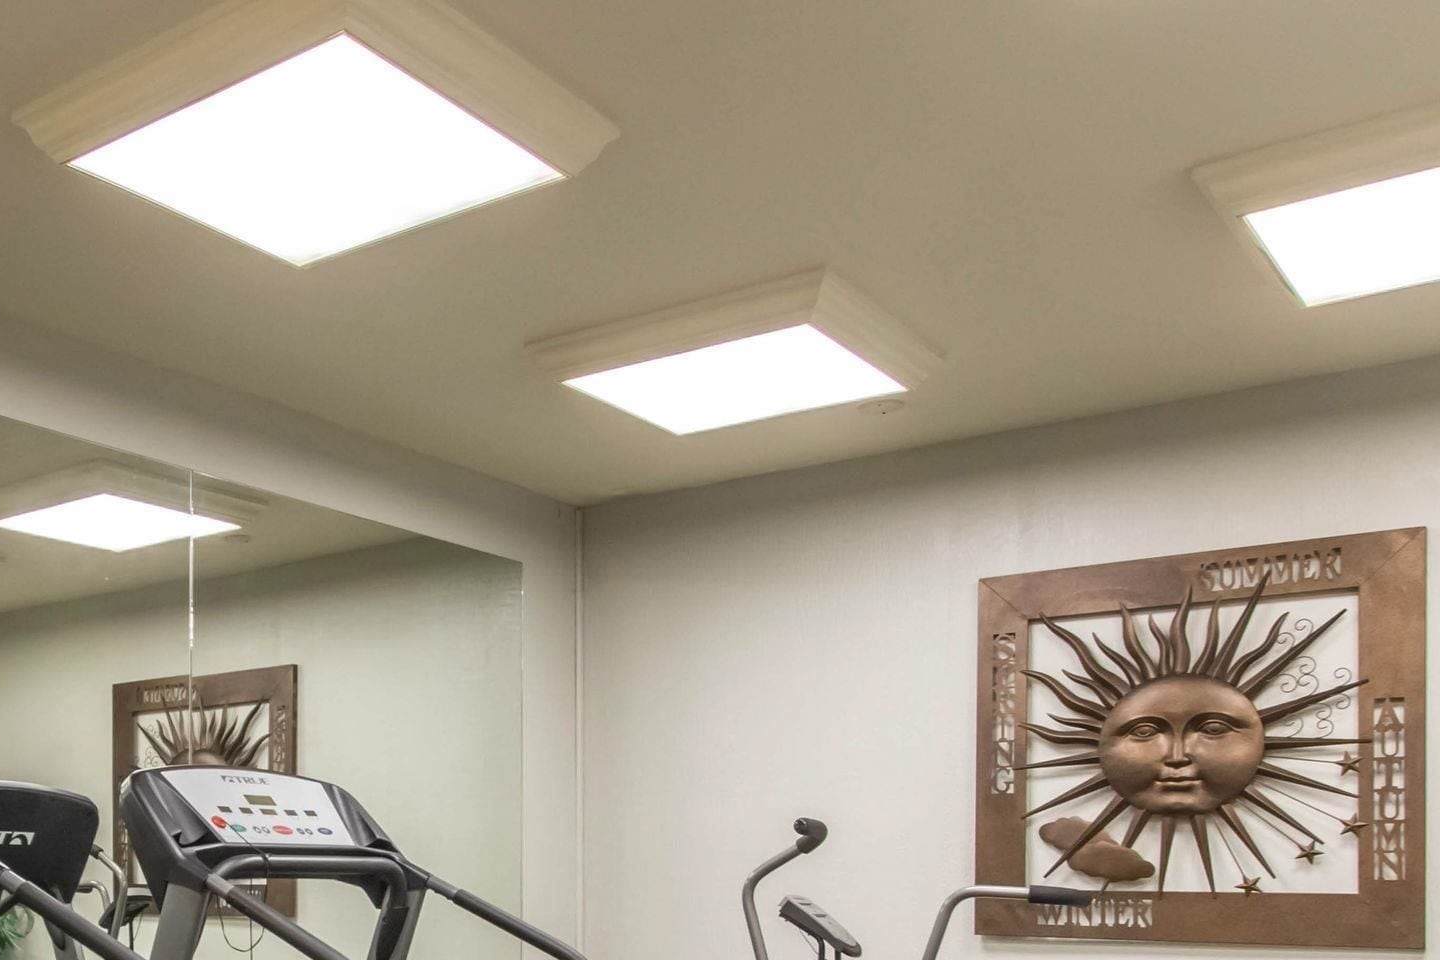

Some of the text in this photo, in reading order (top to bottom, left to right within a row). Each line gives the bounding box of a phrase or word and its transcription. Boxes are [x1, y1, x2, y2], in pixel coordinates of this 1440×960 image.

[1197, 547, 1343, 592] SUMMER
[992, 633, 1016, 794] SPRING
[1373, 697, 1406, 881] AUTUMN
[1036, 898, 1153, 928] WINTER
